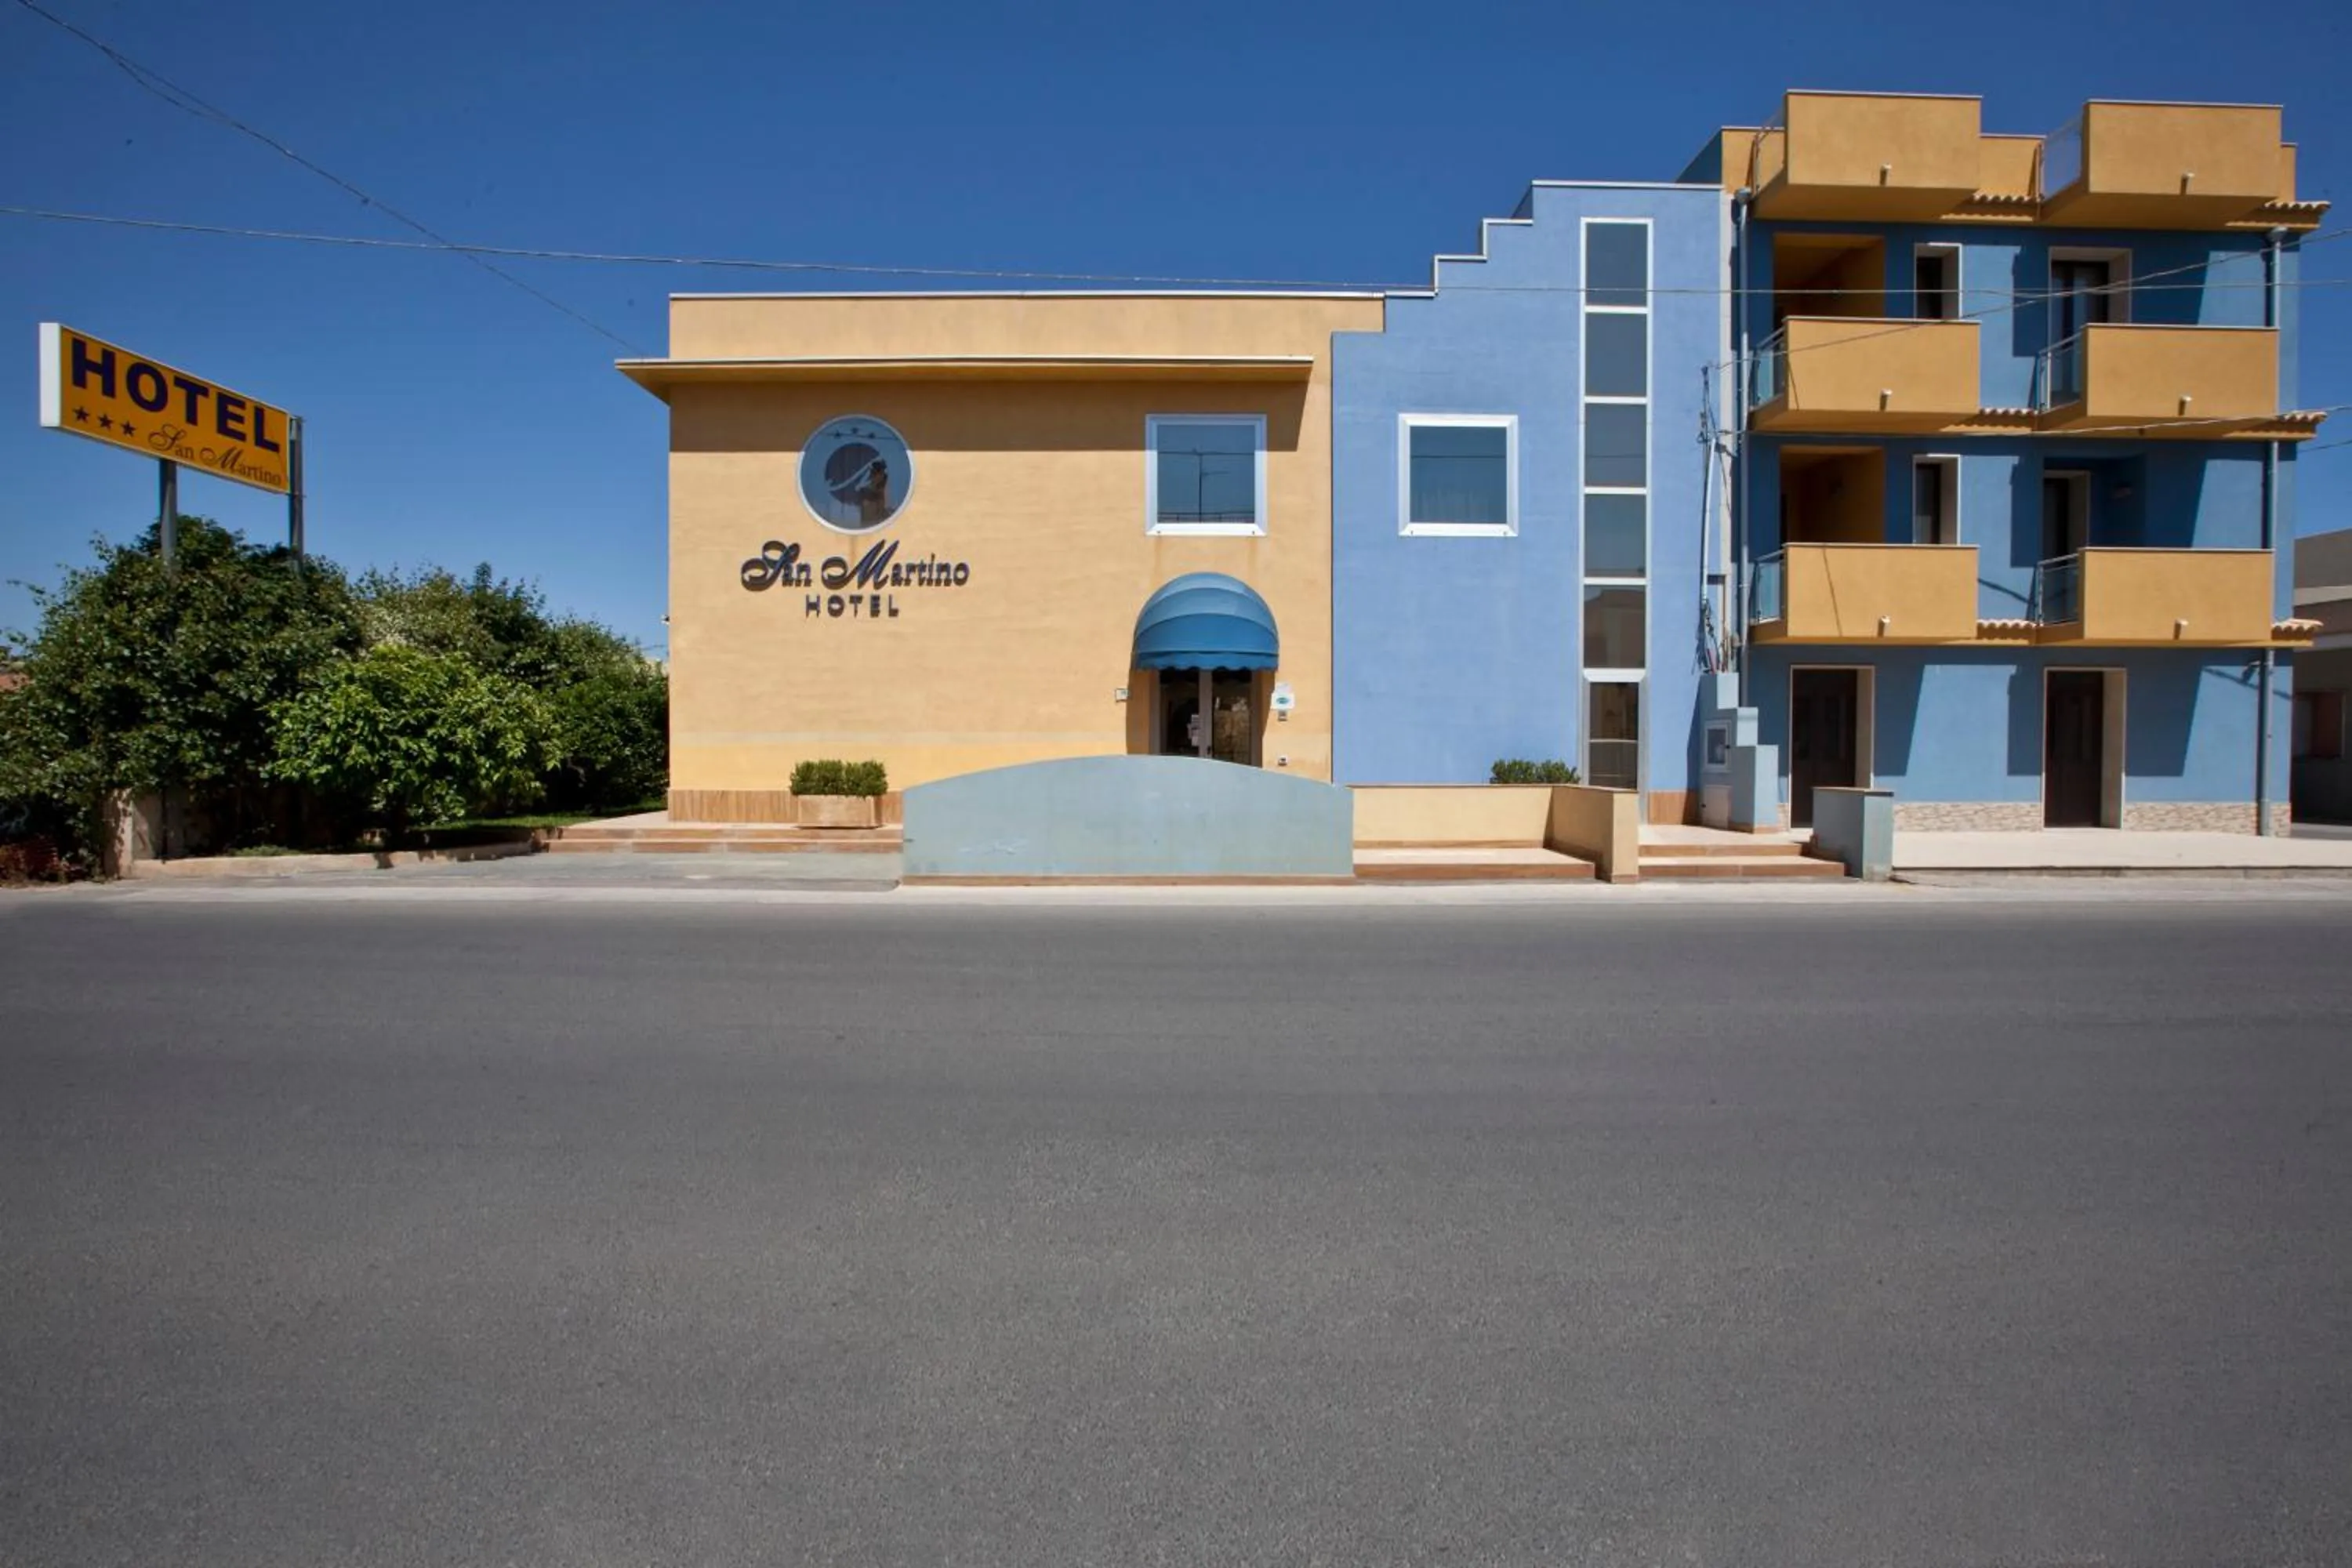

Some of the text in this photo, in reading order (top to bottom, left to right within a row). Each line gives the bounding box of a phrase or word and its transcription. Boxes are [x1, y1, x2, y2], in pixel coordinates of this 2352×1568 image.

[71, 337, 280, 452] HOTEL
[147, 424, 281, 486] San Martino
[741, 539, 970, 591] San Martino
[806, 594, 899, 617] HOTEL
